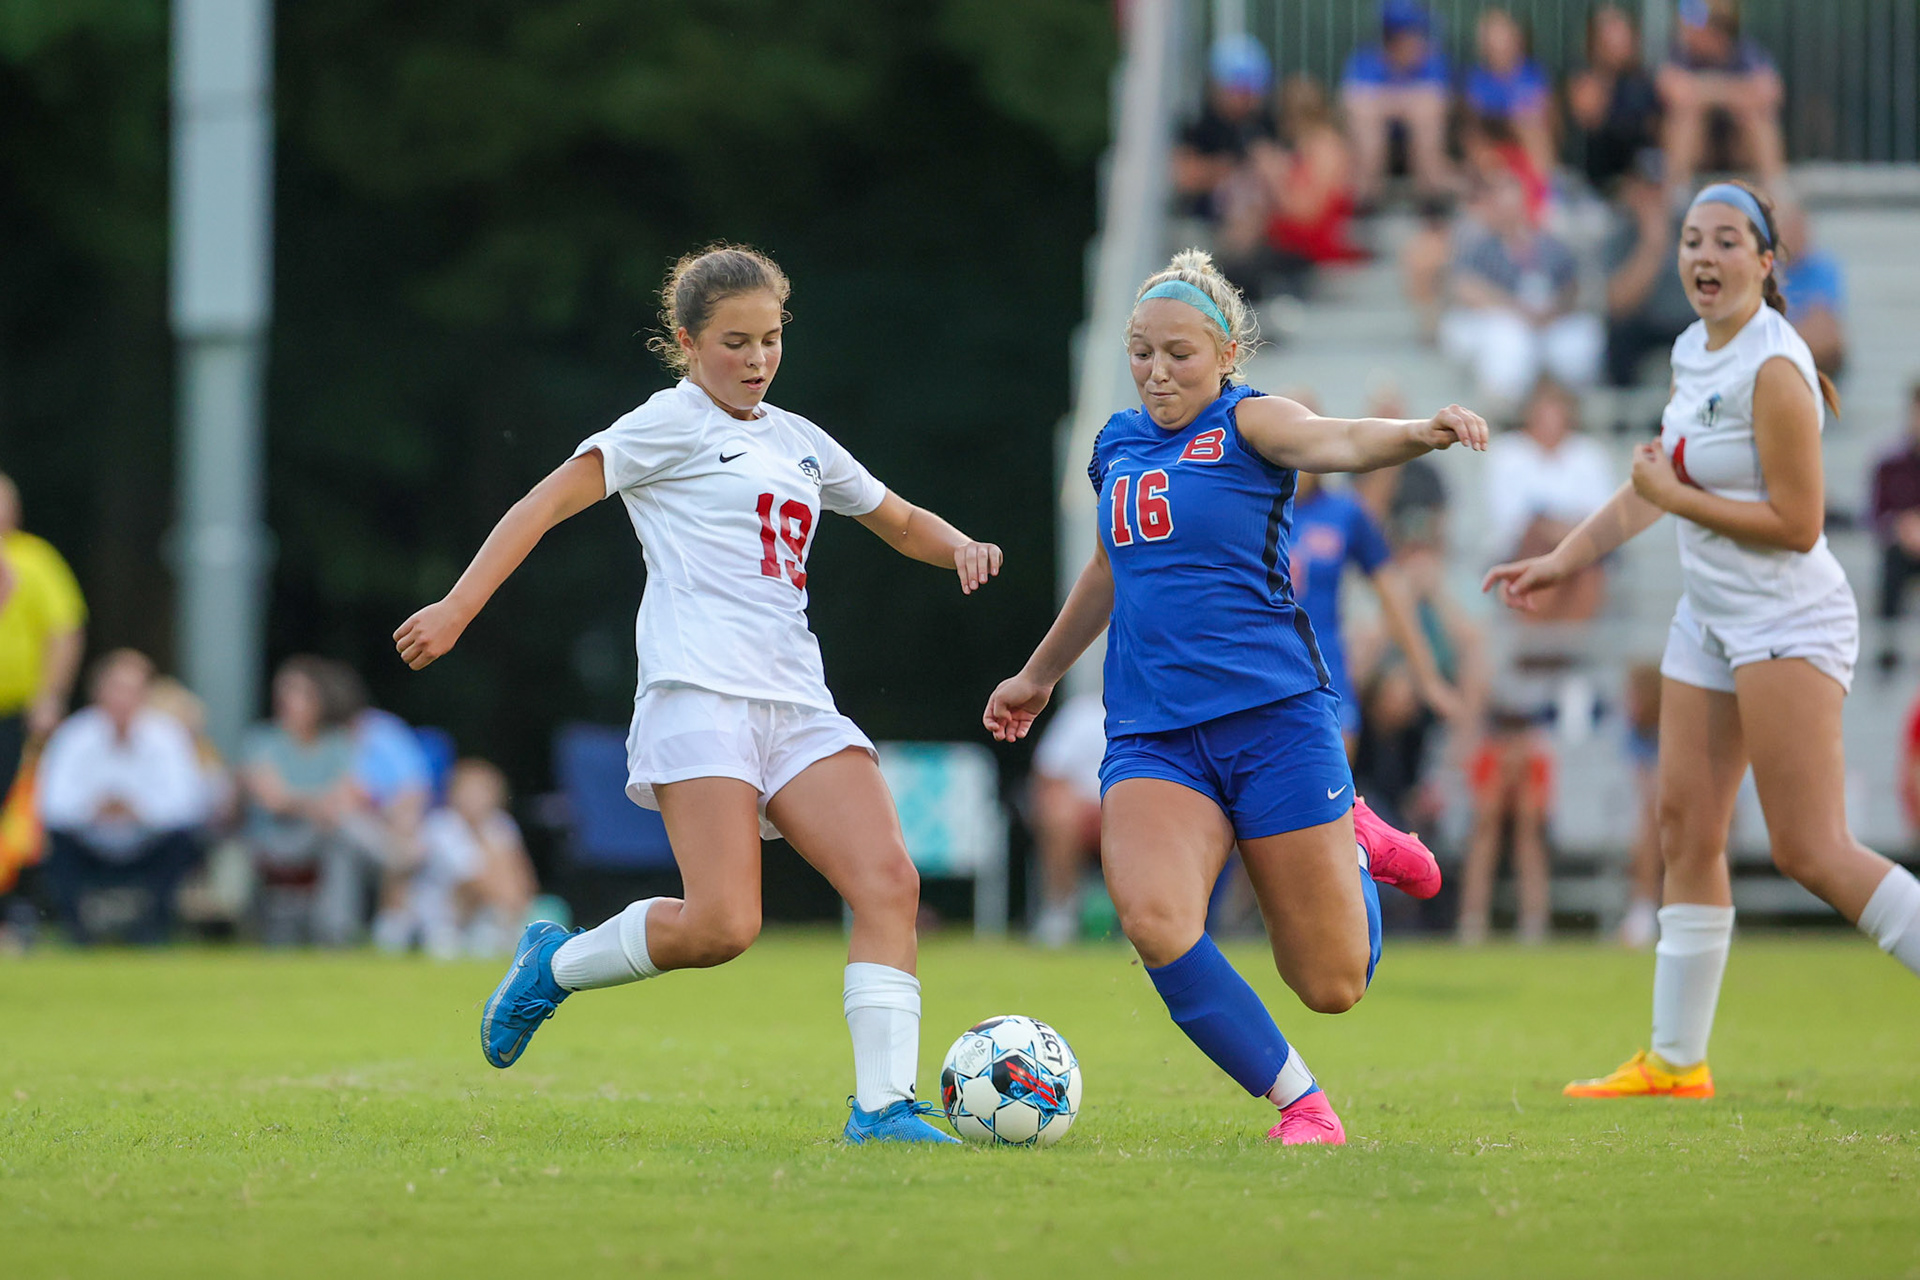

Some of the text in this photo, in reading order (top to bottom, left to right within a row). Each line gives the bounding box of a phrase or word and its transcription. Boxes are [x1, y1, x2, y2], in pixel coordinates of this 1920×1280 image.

[1176, 427, 1226, 464] B
[755, 492, 813, 591] 19
[1110, 468, 1174, 547] 16
